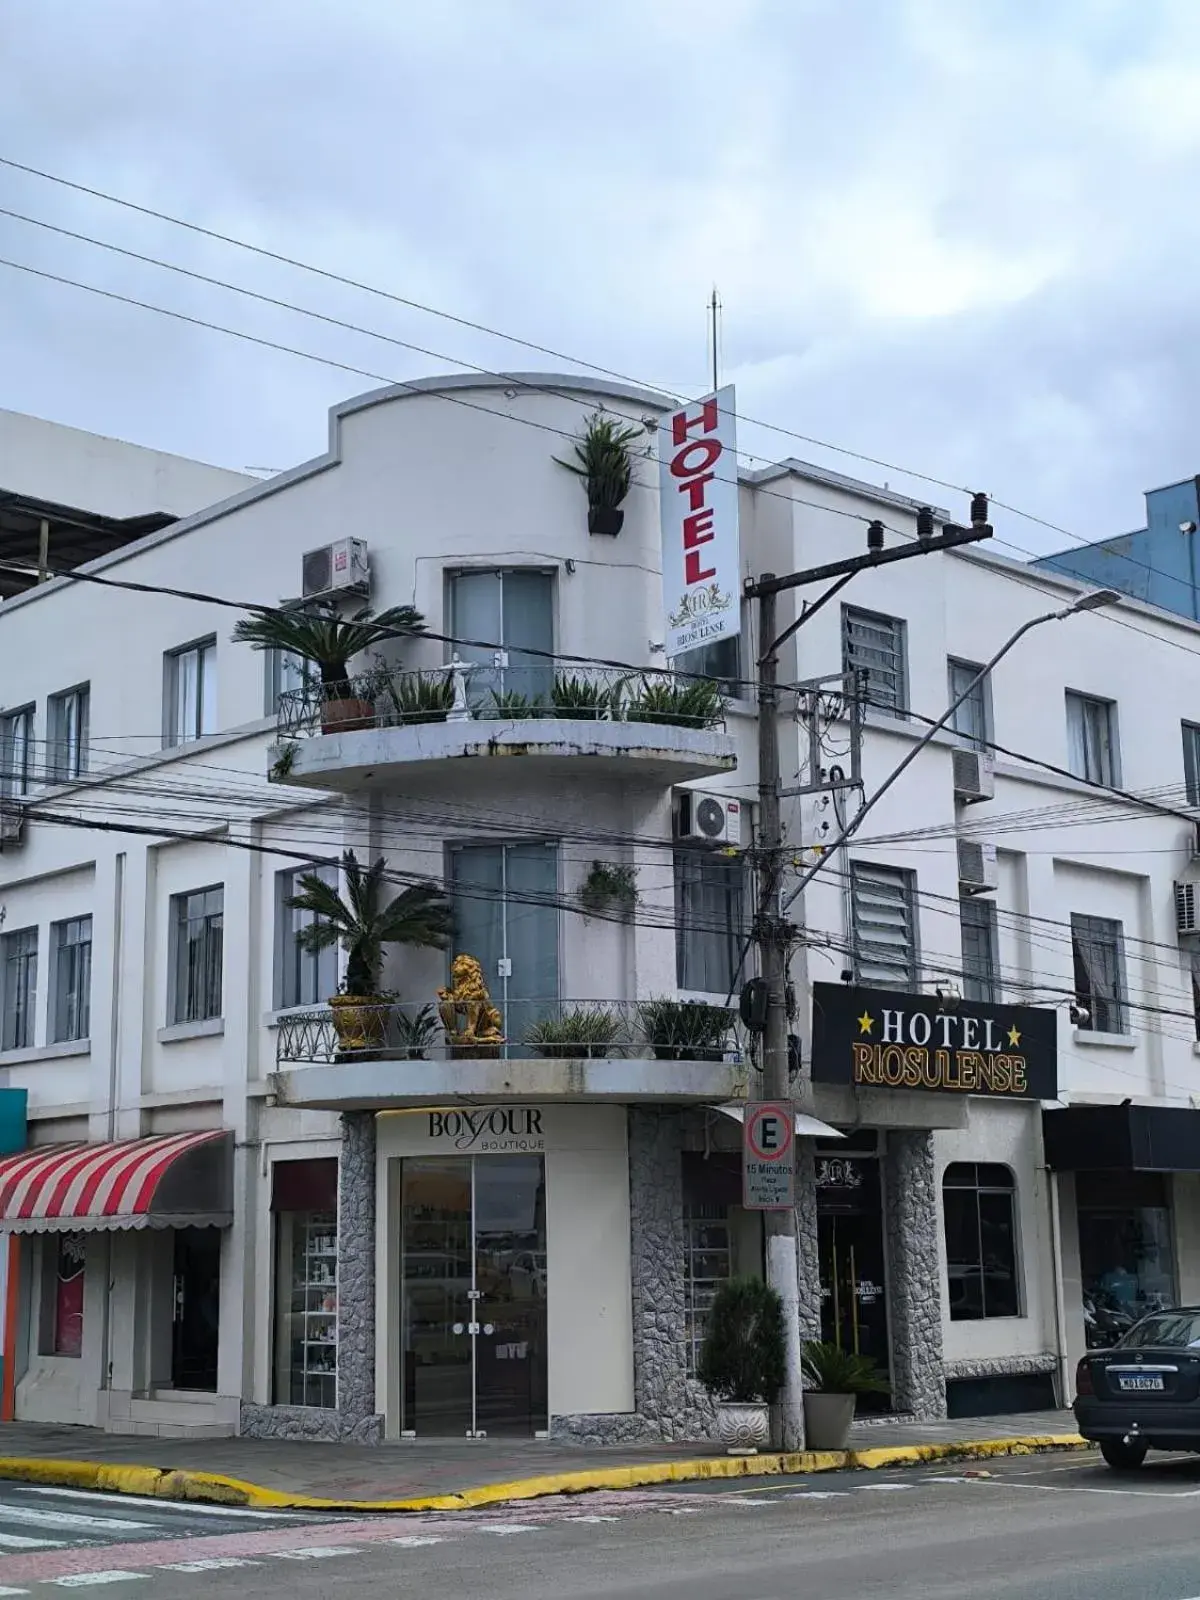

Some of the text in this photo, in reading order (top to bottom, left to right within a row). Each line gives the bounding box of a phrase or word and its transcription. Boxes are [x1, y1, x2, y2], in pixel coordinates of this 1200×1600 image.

[670, 397, 722, 585] HOTEL
[881, 1009, 1002, 1051] HOTEL
[852, 1042, 1027, 1092] RIOSULENSE
[429, 1107, 543, 1149] BONJOUR
[481, 1139, 545, 1150] BOUTIQUE
[762, 1118, 777, 1148] E
[747, 1164, 793, 1174] 15 Minutos
